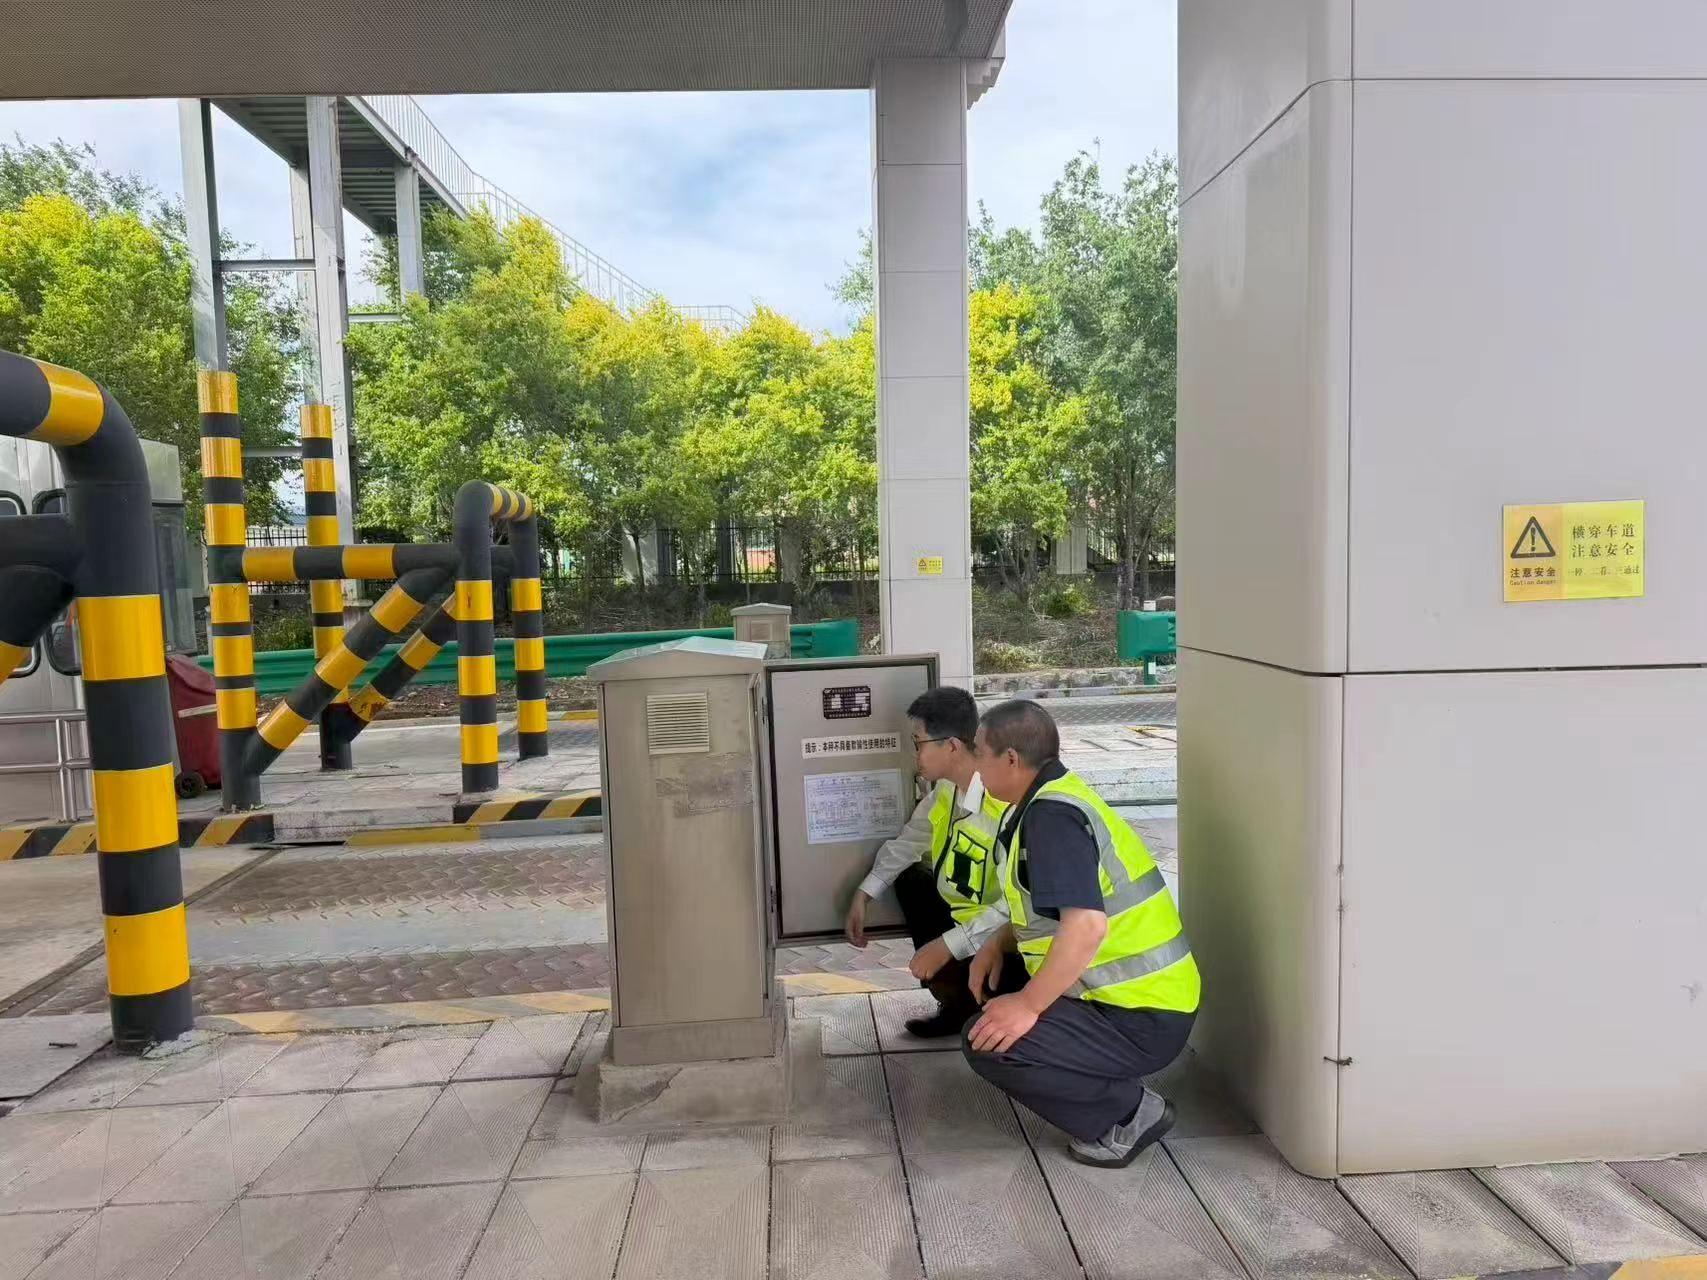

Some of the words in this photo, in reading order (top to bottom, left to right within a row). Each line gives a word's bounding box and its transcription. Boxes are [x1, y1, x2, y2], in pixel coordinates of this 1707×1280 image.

[1572, 523, 1635, 540] 横穿车道
[1572, 542, 1635, 558] 注意安全
[1510, 566, 1556, 578] 注意安全
